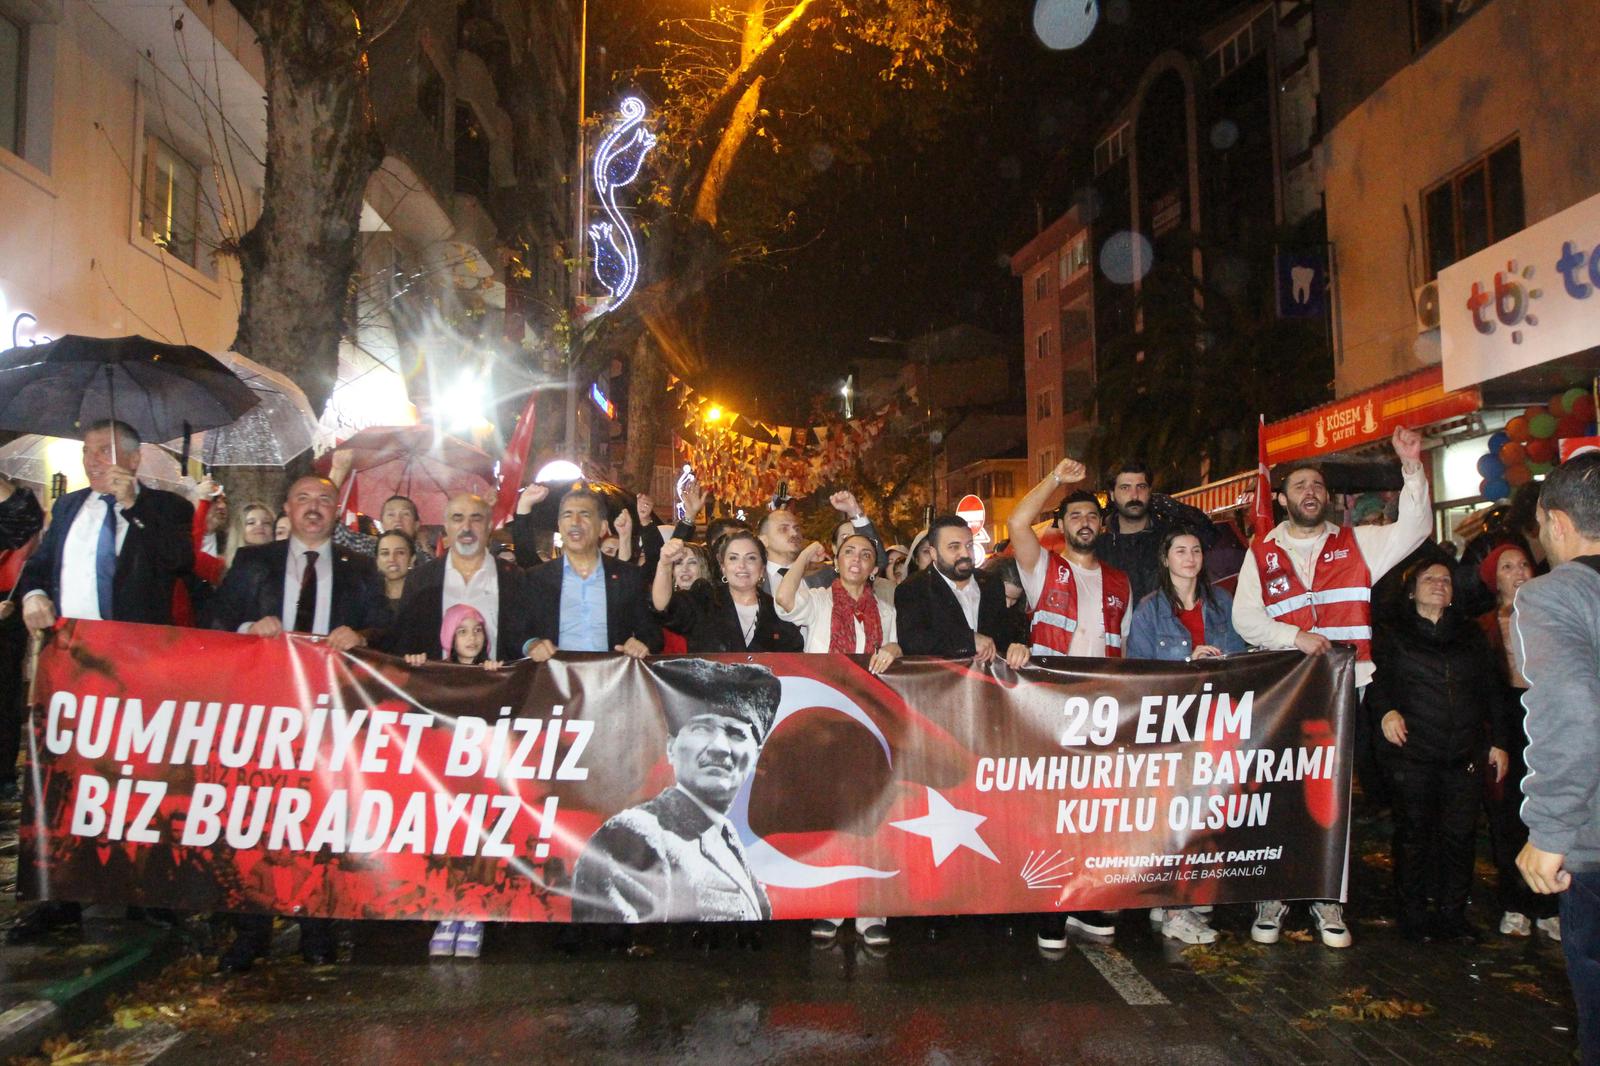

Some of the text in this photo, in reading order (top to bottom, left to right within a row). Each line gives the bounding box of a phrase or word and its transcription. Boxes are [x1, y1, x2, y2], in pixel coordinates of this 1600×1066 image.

[46, 690, 595, 780] CUMHURİYET BİZİZ
[1060, 683, 1255, 746] 29 EKİM
[975, 745, 1335, 792] CUMHURİYET BAYRAMI
[70, 765, 559, 857] BİZ BURADAYIZ !
[1056, 793, 1271, 834] KUTLU OLSUN
[1085, 846, 1283, 869] CUMHURİYET HALK PARTİSİ
[1104, 865, 1266, 884] ORHANGAZİ İLÇE BAŞKANLIĞI
